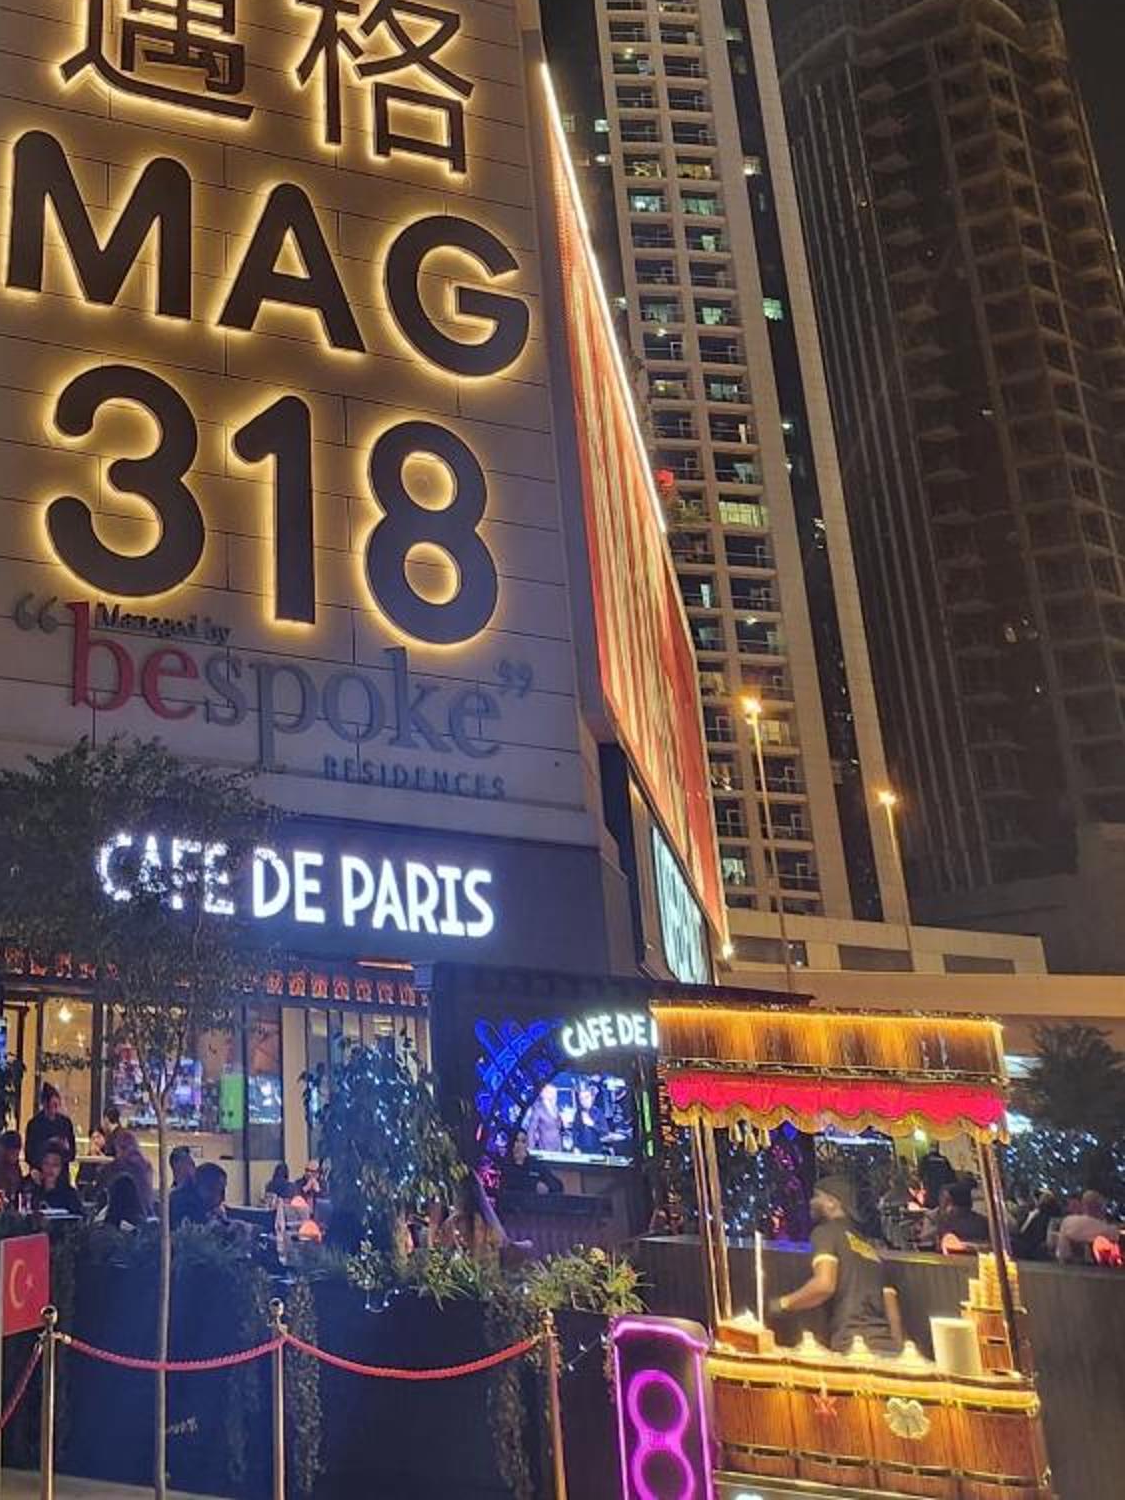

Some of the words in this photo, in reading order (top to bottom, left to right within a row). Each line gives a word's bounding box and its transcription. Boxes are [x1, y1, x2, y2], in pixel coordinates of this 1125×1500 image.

[5, 129, 530, 377] MAG
[45, 364, 499, 644] 318
[95, 602, 197, 638] Managed
[323, 755, 506, 799] RESIDENCES
[96, 832, 236, 915] CAFE
[251, 846, 325, 924] DE
[340, 853, 496, 939] PARIS
[562, 1013, 618, 1057] CAFE
[616, 1011, 649, 1047] DE
